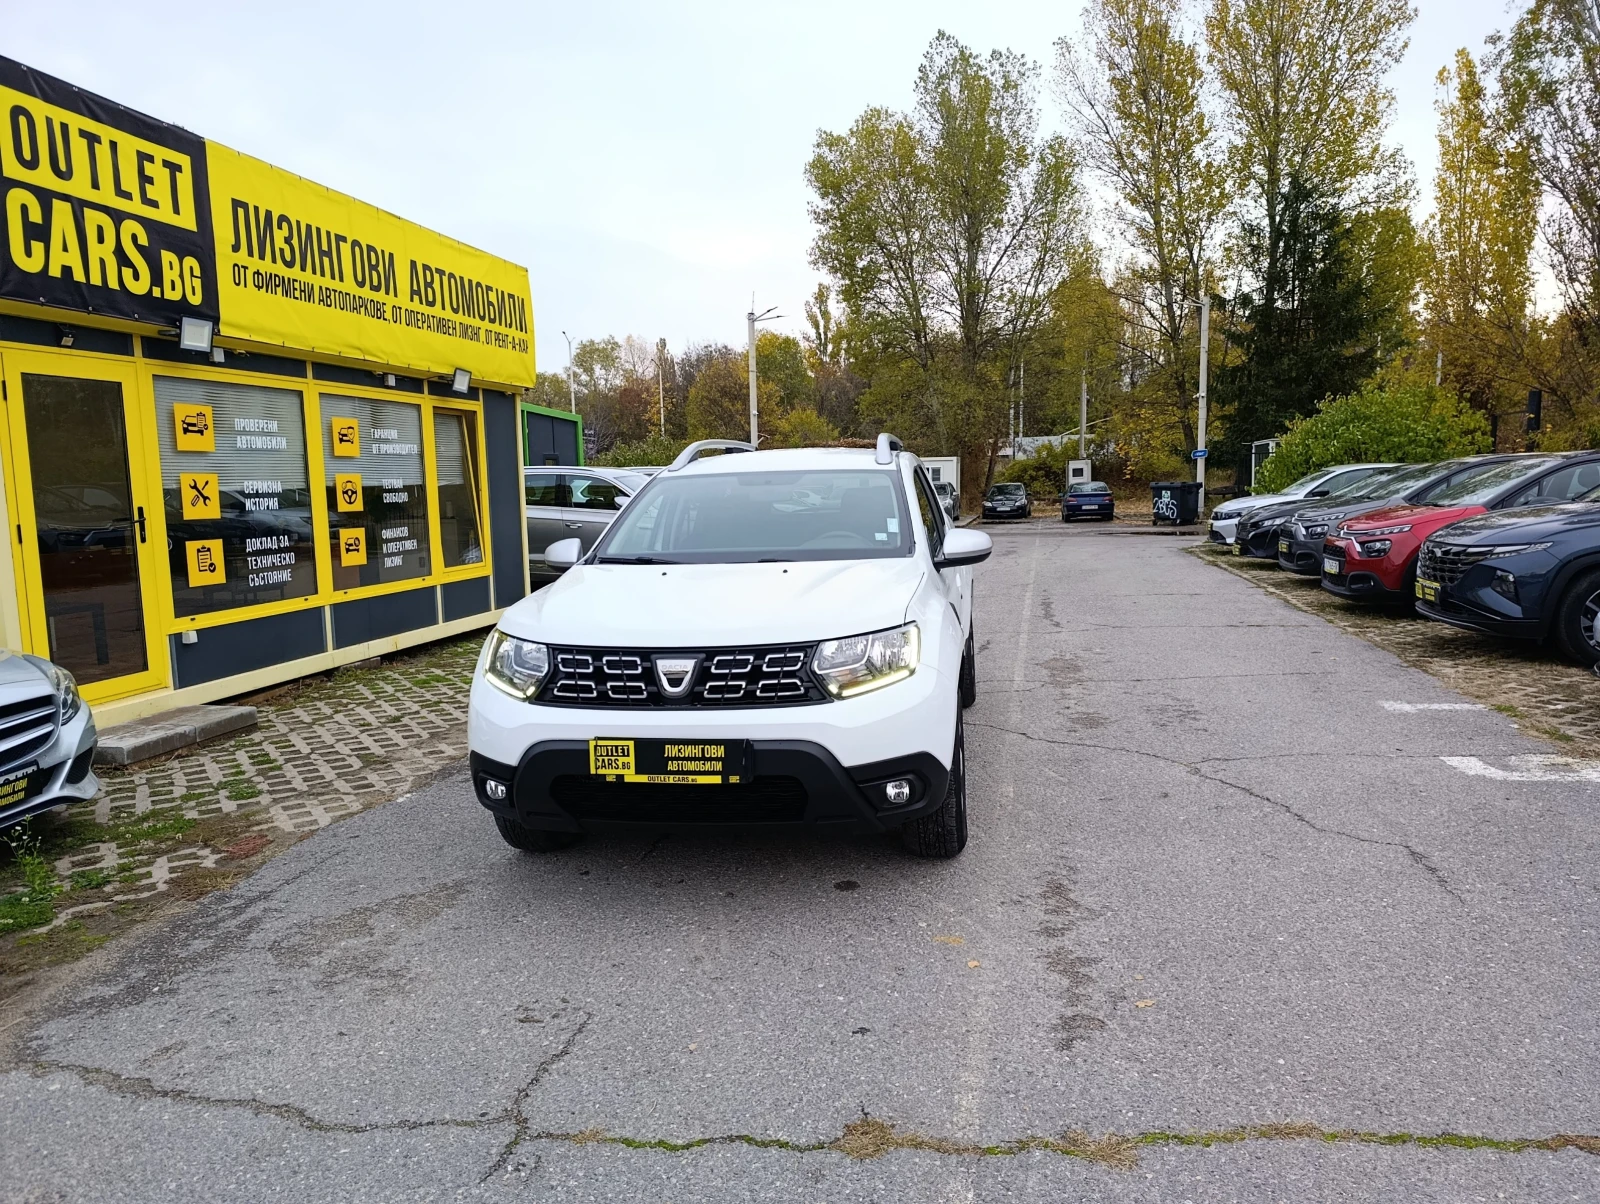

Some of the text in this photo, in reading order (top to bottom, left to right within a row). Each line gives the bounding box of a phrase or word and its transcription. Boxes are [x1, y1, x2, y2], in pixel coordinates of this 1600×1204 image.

[9, 105, 183, 216] OUTLET
[5, 187, 203, 306] CARS.BG
[231, 197, 529, 335] ЛИЗИНГОВИ АВТОМОБИЛИ
[232, 263, 249, 289] ОТ
[252, 269, 316, 305] ФИРМЕНИ
[318, 285, 391, 325] АВТОПАРКОВЕ,
[391, 304, 403, 325] ОТ
[404, 308, 458, 339] ОПЕРАТИВЕН
[485, 328, 493, 346] ОТ
[234, 418, 279, 433] ПРОВЕРЕНИ
[236, 435, 288, 450] АВТОМОБИЛИ
[243, 481, 283, 494] СЕРВИЗНА
[245, 497, 279, 511] ИСТОРИЯ
[382, 526, 409, 539] ФИНАНСОВ
[246, 535, 290, 553] ДОКЛАД ЗА
[382, 539, 418, 554] И ОПЕРАТИВЕН
[247, 552, 296, 570] ТЕХНИЧЕСКО
[384, 554, 404, 568] ЛИЗИНГ
[248, 569, 293, 587] СЪСТОЯНИЕ
[596, 745, 629, 756] OUTLET
[664, 744, 725, 758] ЛИЗИНГОВИ
[595, 757, 631, 770] CARS.BG
[667, 760, 723, 772] АВТОМОБИЛИ
[647, 775, 671, 783] OUTLET
